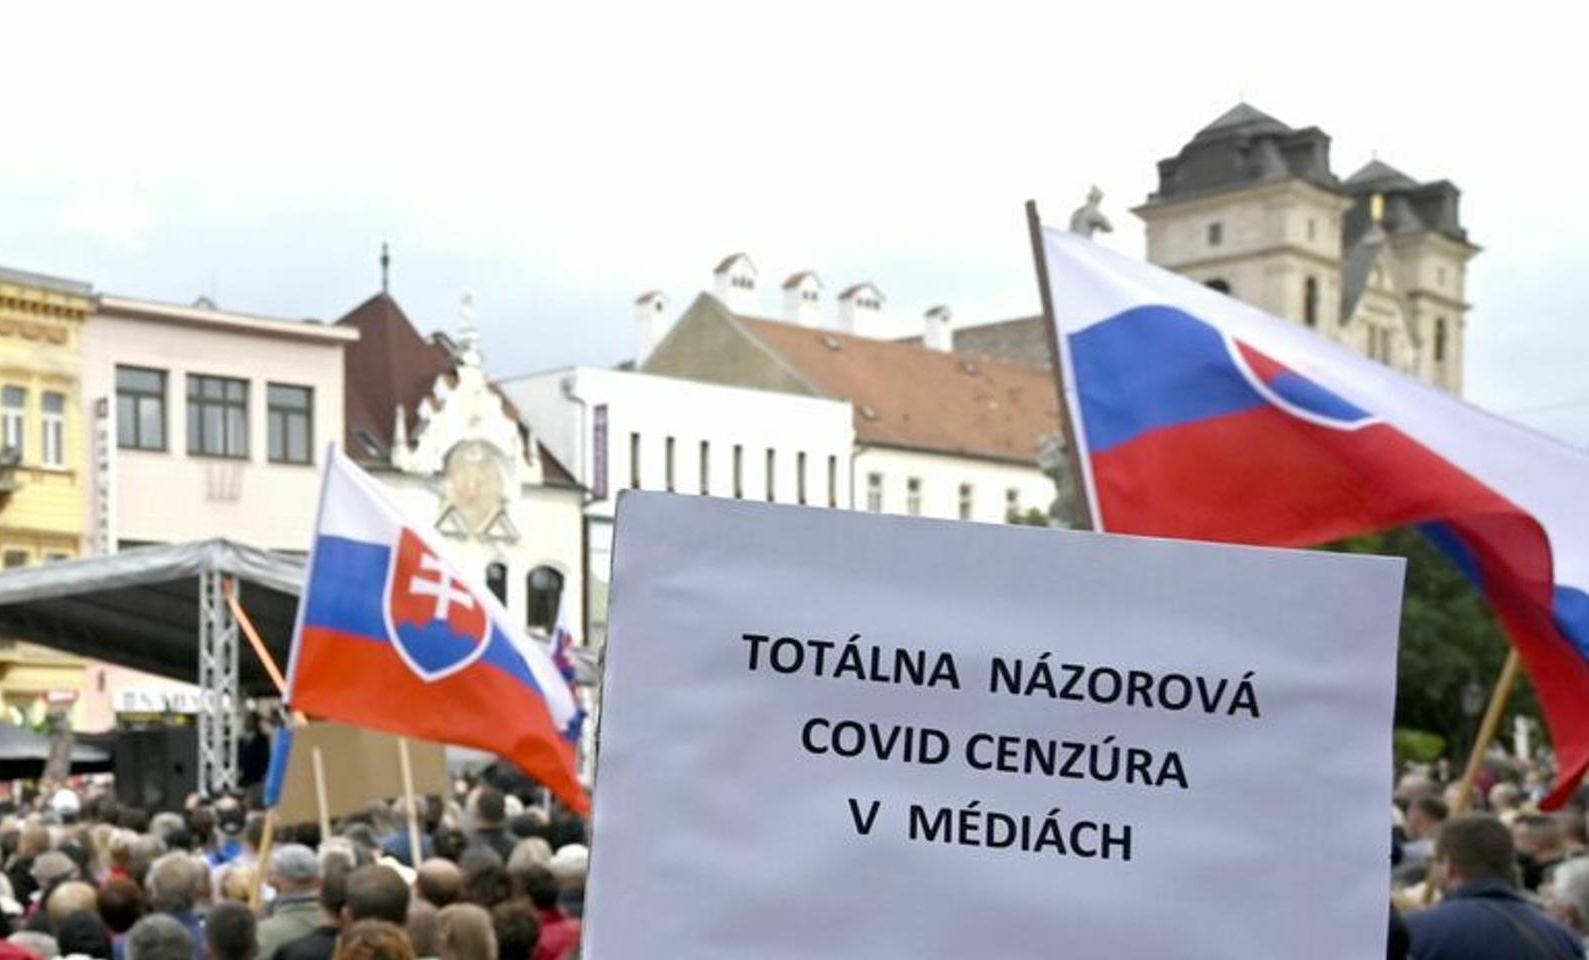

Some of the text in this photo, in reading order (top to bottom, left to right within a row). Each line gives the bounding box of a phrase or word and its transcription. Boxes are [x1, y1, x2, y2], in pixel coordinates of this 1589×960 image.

[742, 634, 1260, 719] TOTÁLNA NÁZOROVÁ
[802, 717, 1189, 789] COVID CENZÚRA
[848, 798, 1131, 861] V MÉDIÁCH
